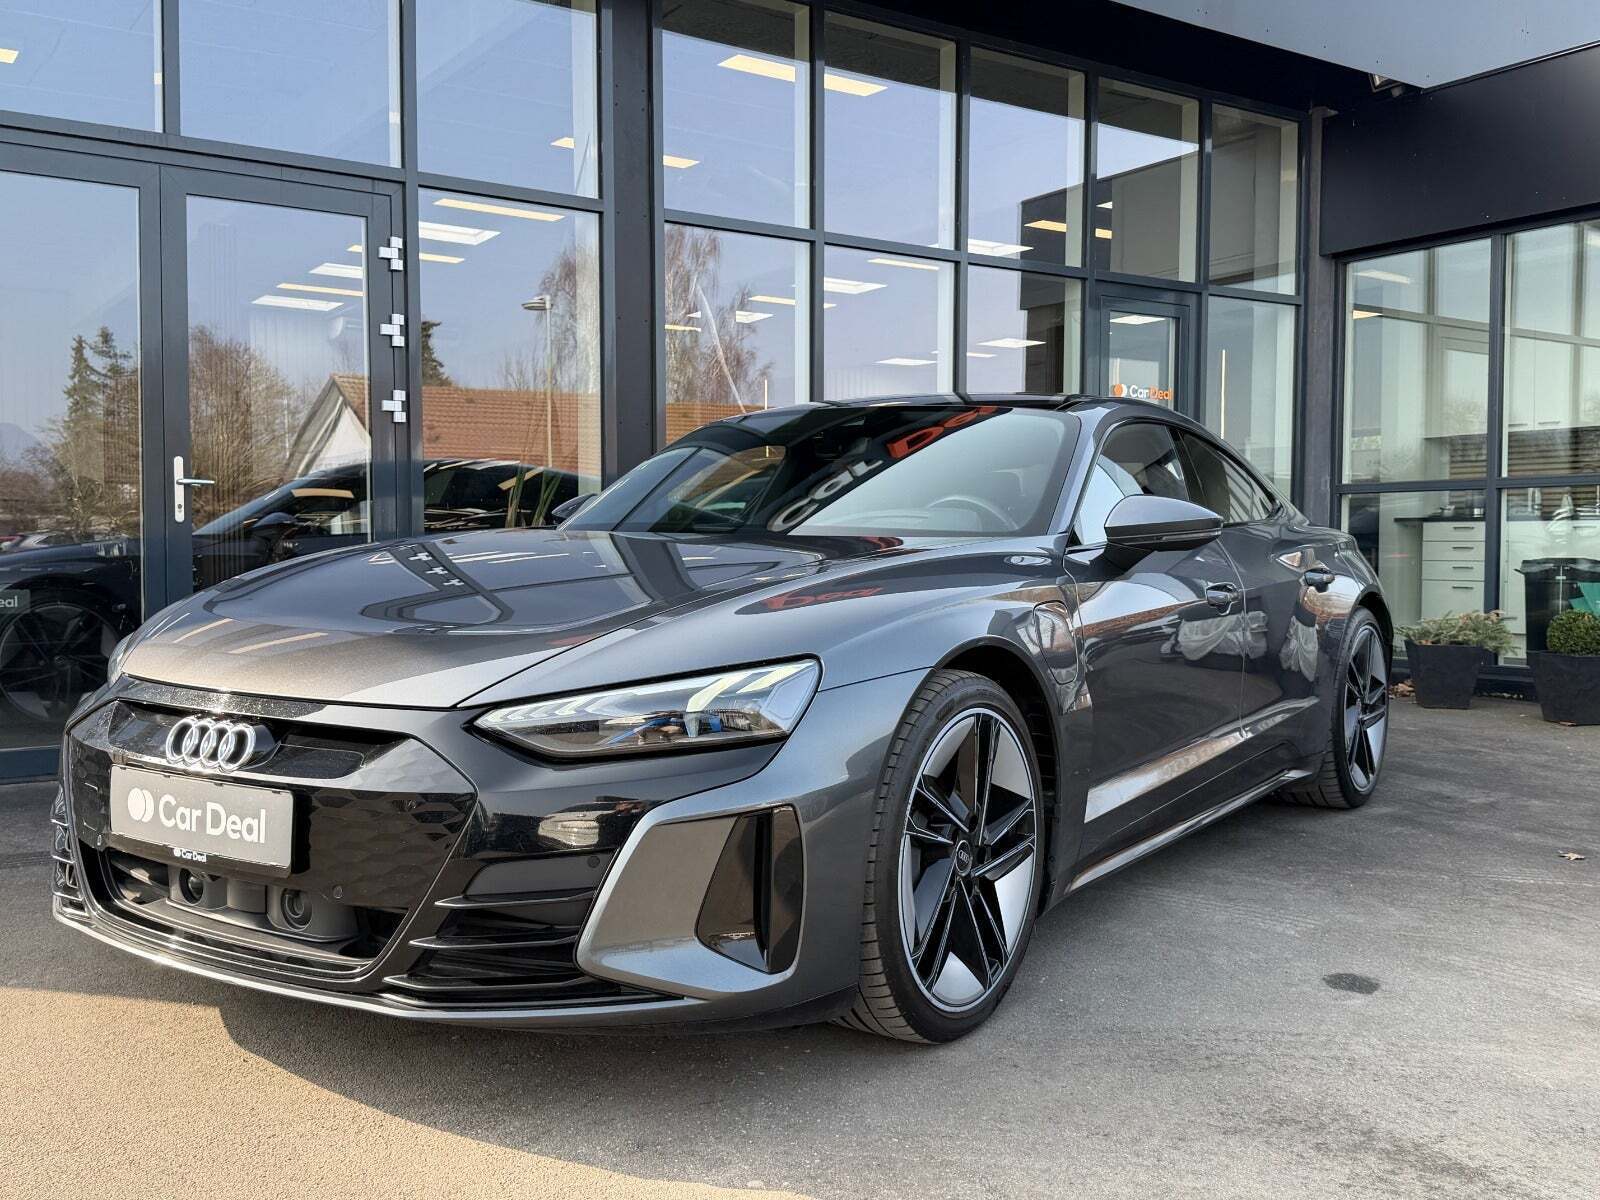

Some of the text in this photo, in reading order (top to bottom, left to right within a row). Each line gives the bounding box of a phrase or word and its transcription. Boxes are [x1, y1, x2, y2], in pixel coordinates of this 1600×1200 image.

[1129, 384, 1173, 400] Car Deal
[158, 794, 266, 844] Car Deal
[181, 848, 192, 860] Car
